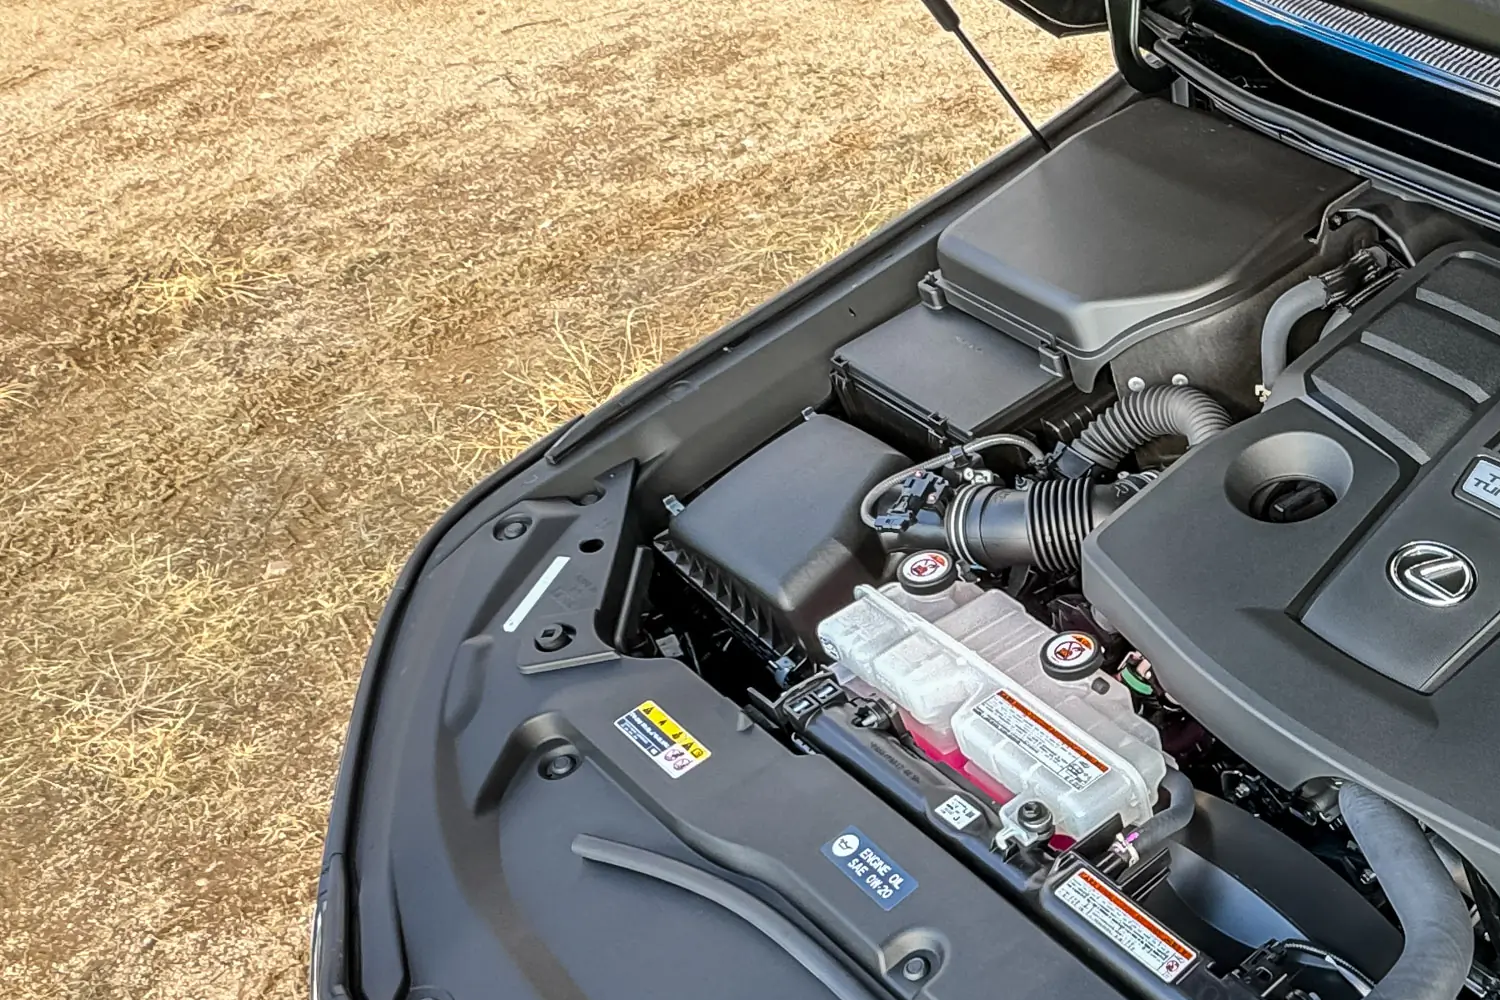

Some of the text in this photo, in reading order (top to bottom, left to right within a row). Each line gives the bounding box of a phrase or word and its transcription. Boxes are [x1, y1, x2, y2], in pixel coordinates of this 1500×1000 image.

[847, 858, 893, 898] SAE 0W-20
[859, 848, 904, 890] ENGINE OIL
